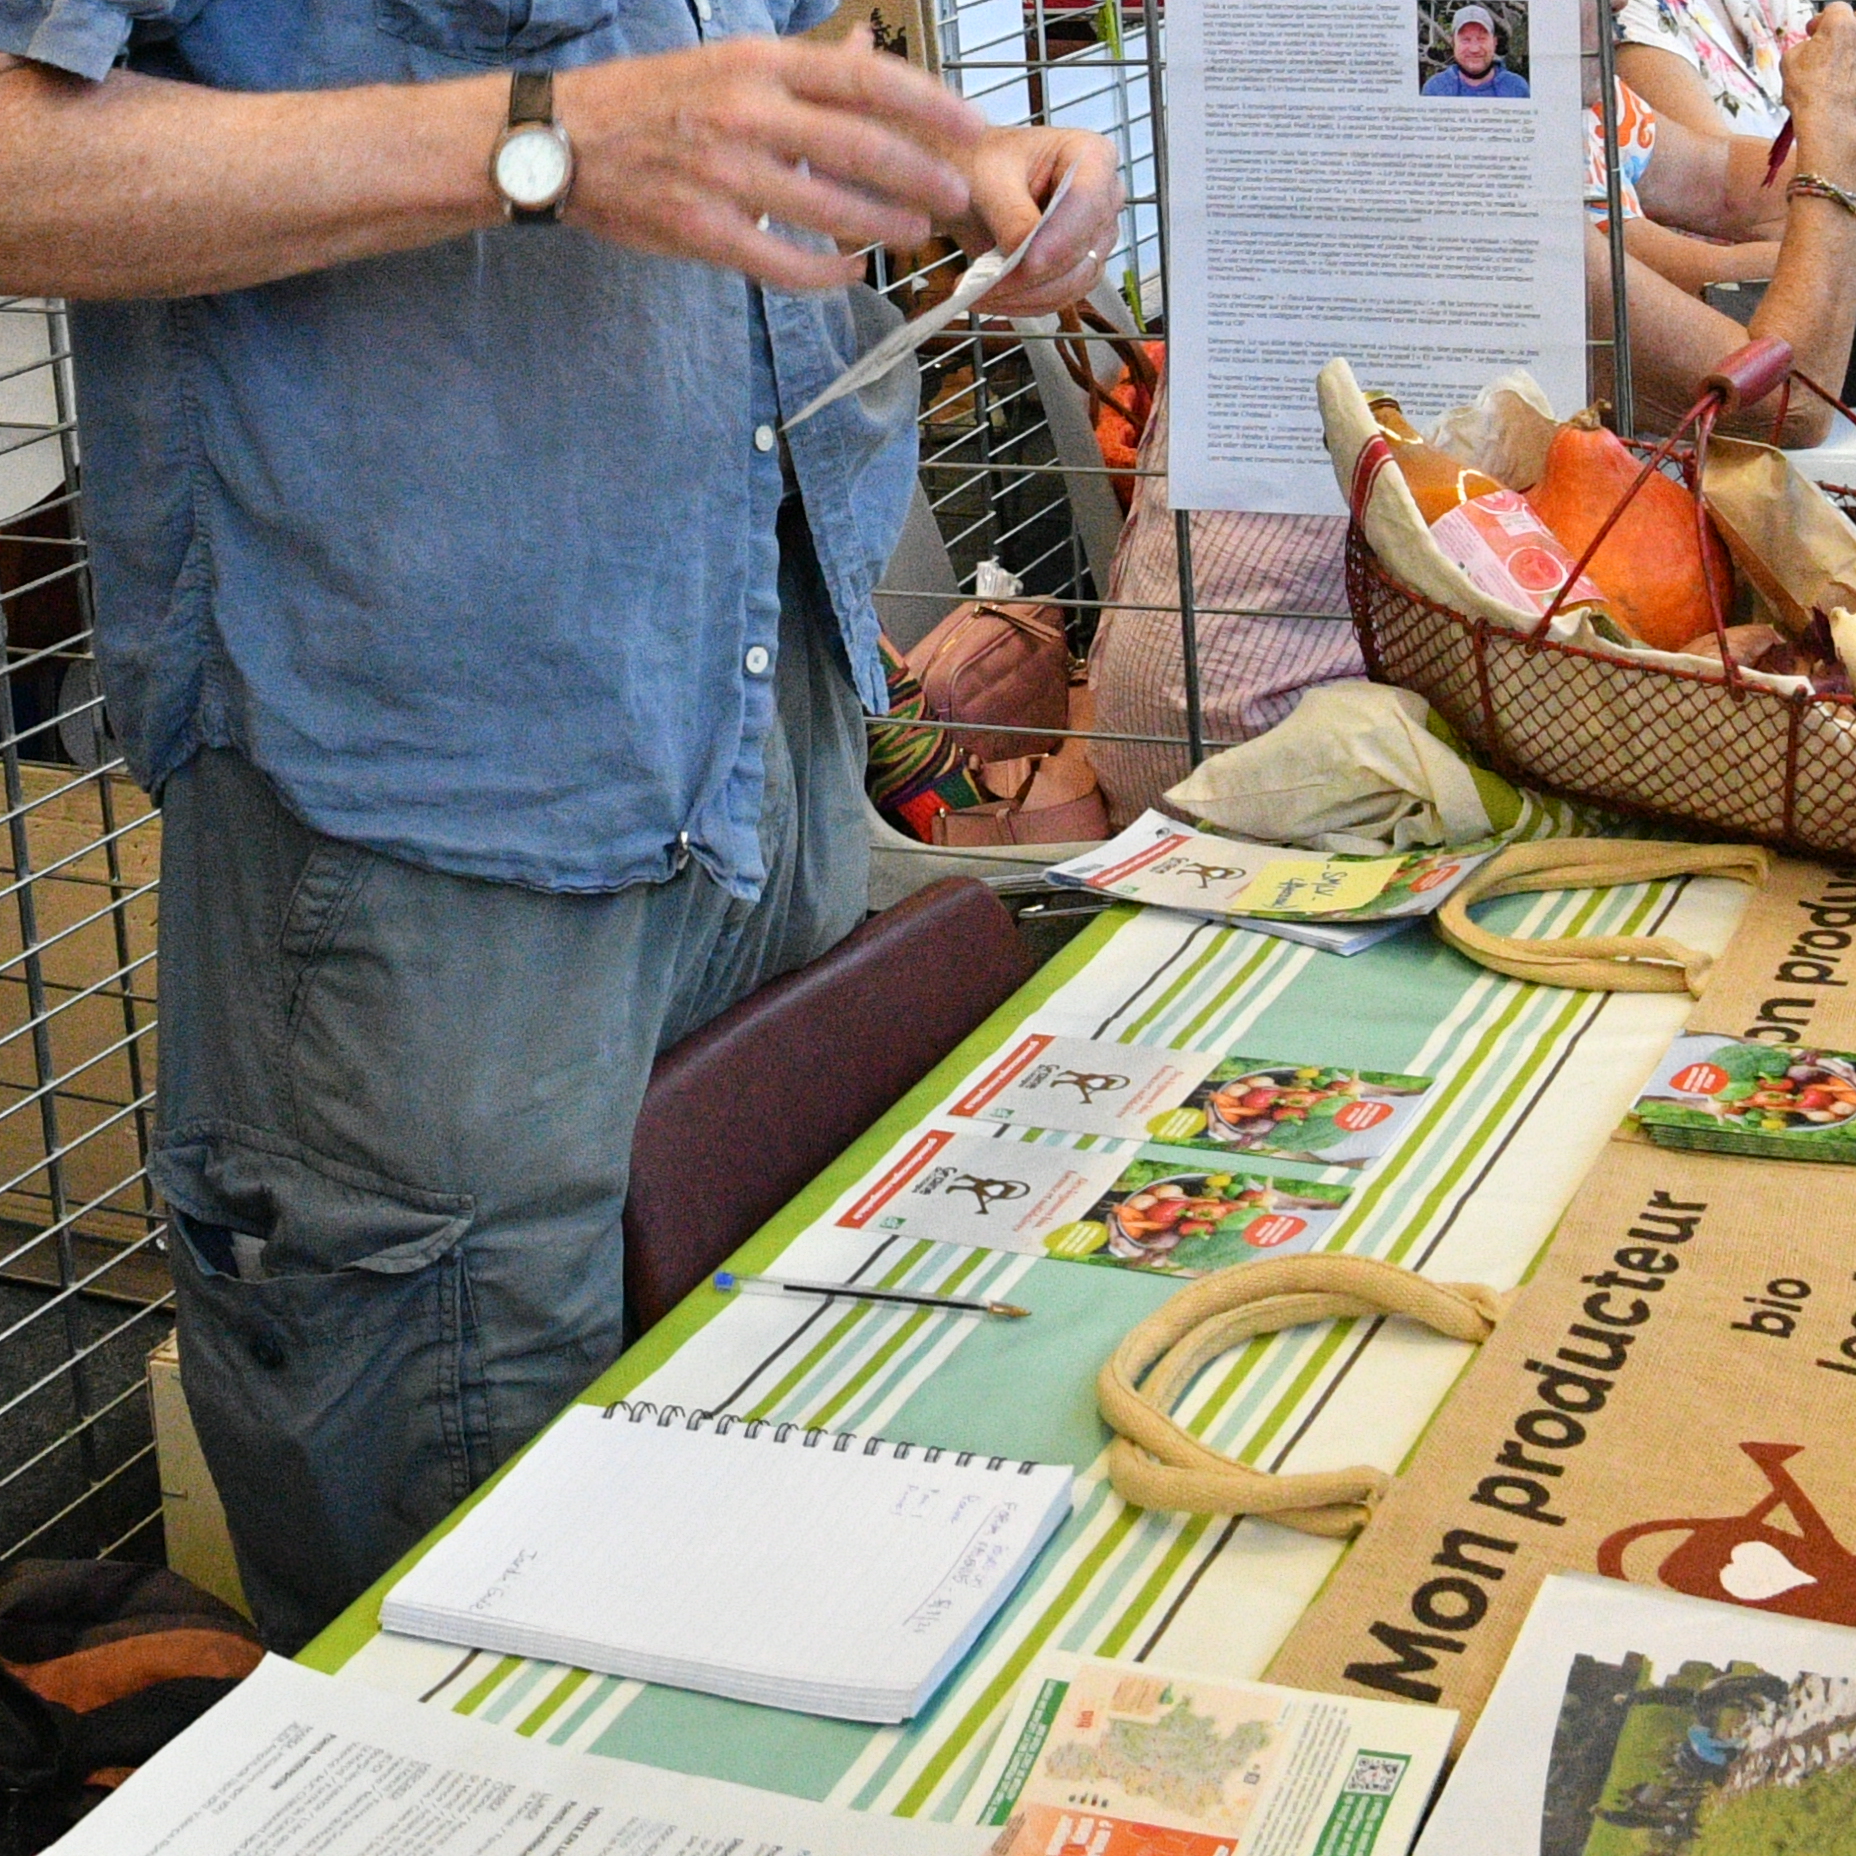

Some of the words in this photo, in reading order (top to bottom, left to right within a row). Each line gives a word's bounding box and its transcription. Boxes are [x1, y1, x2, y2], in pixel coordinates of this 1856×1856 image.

[1346, 1525, 1508, 1703] Mon
[1470, 1190, 1708, 1527] producteur
[1733, 1276, 1811, 1340] bio
